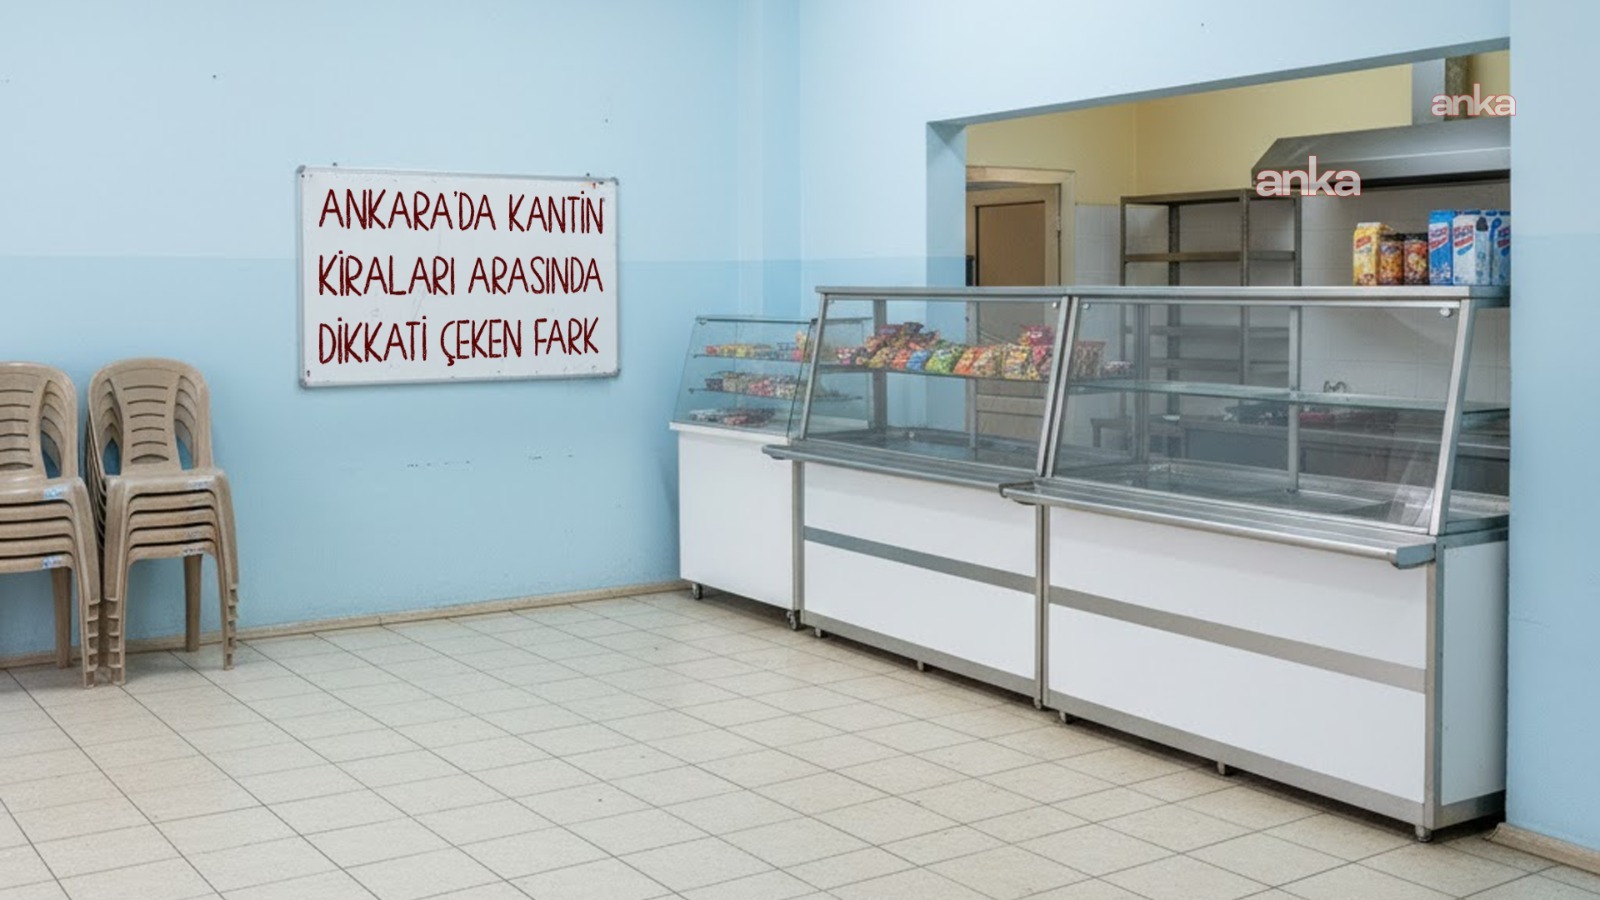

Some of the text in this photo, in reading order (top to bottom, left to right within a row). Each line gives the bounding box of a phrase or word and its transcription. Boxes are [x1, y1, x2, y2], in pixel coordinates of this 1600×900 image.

[320, 189, 603, 233] ANKARA'DA KANTİN
[319, 250, 603, 296] KİRALARI ARASINDA
[319, 316, 598, 366] DİKKATİ ÇEKEN FARK
